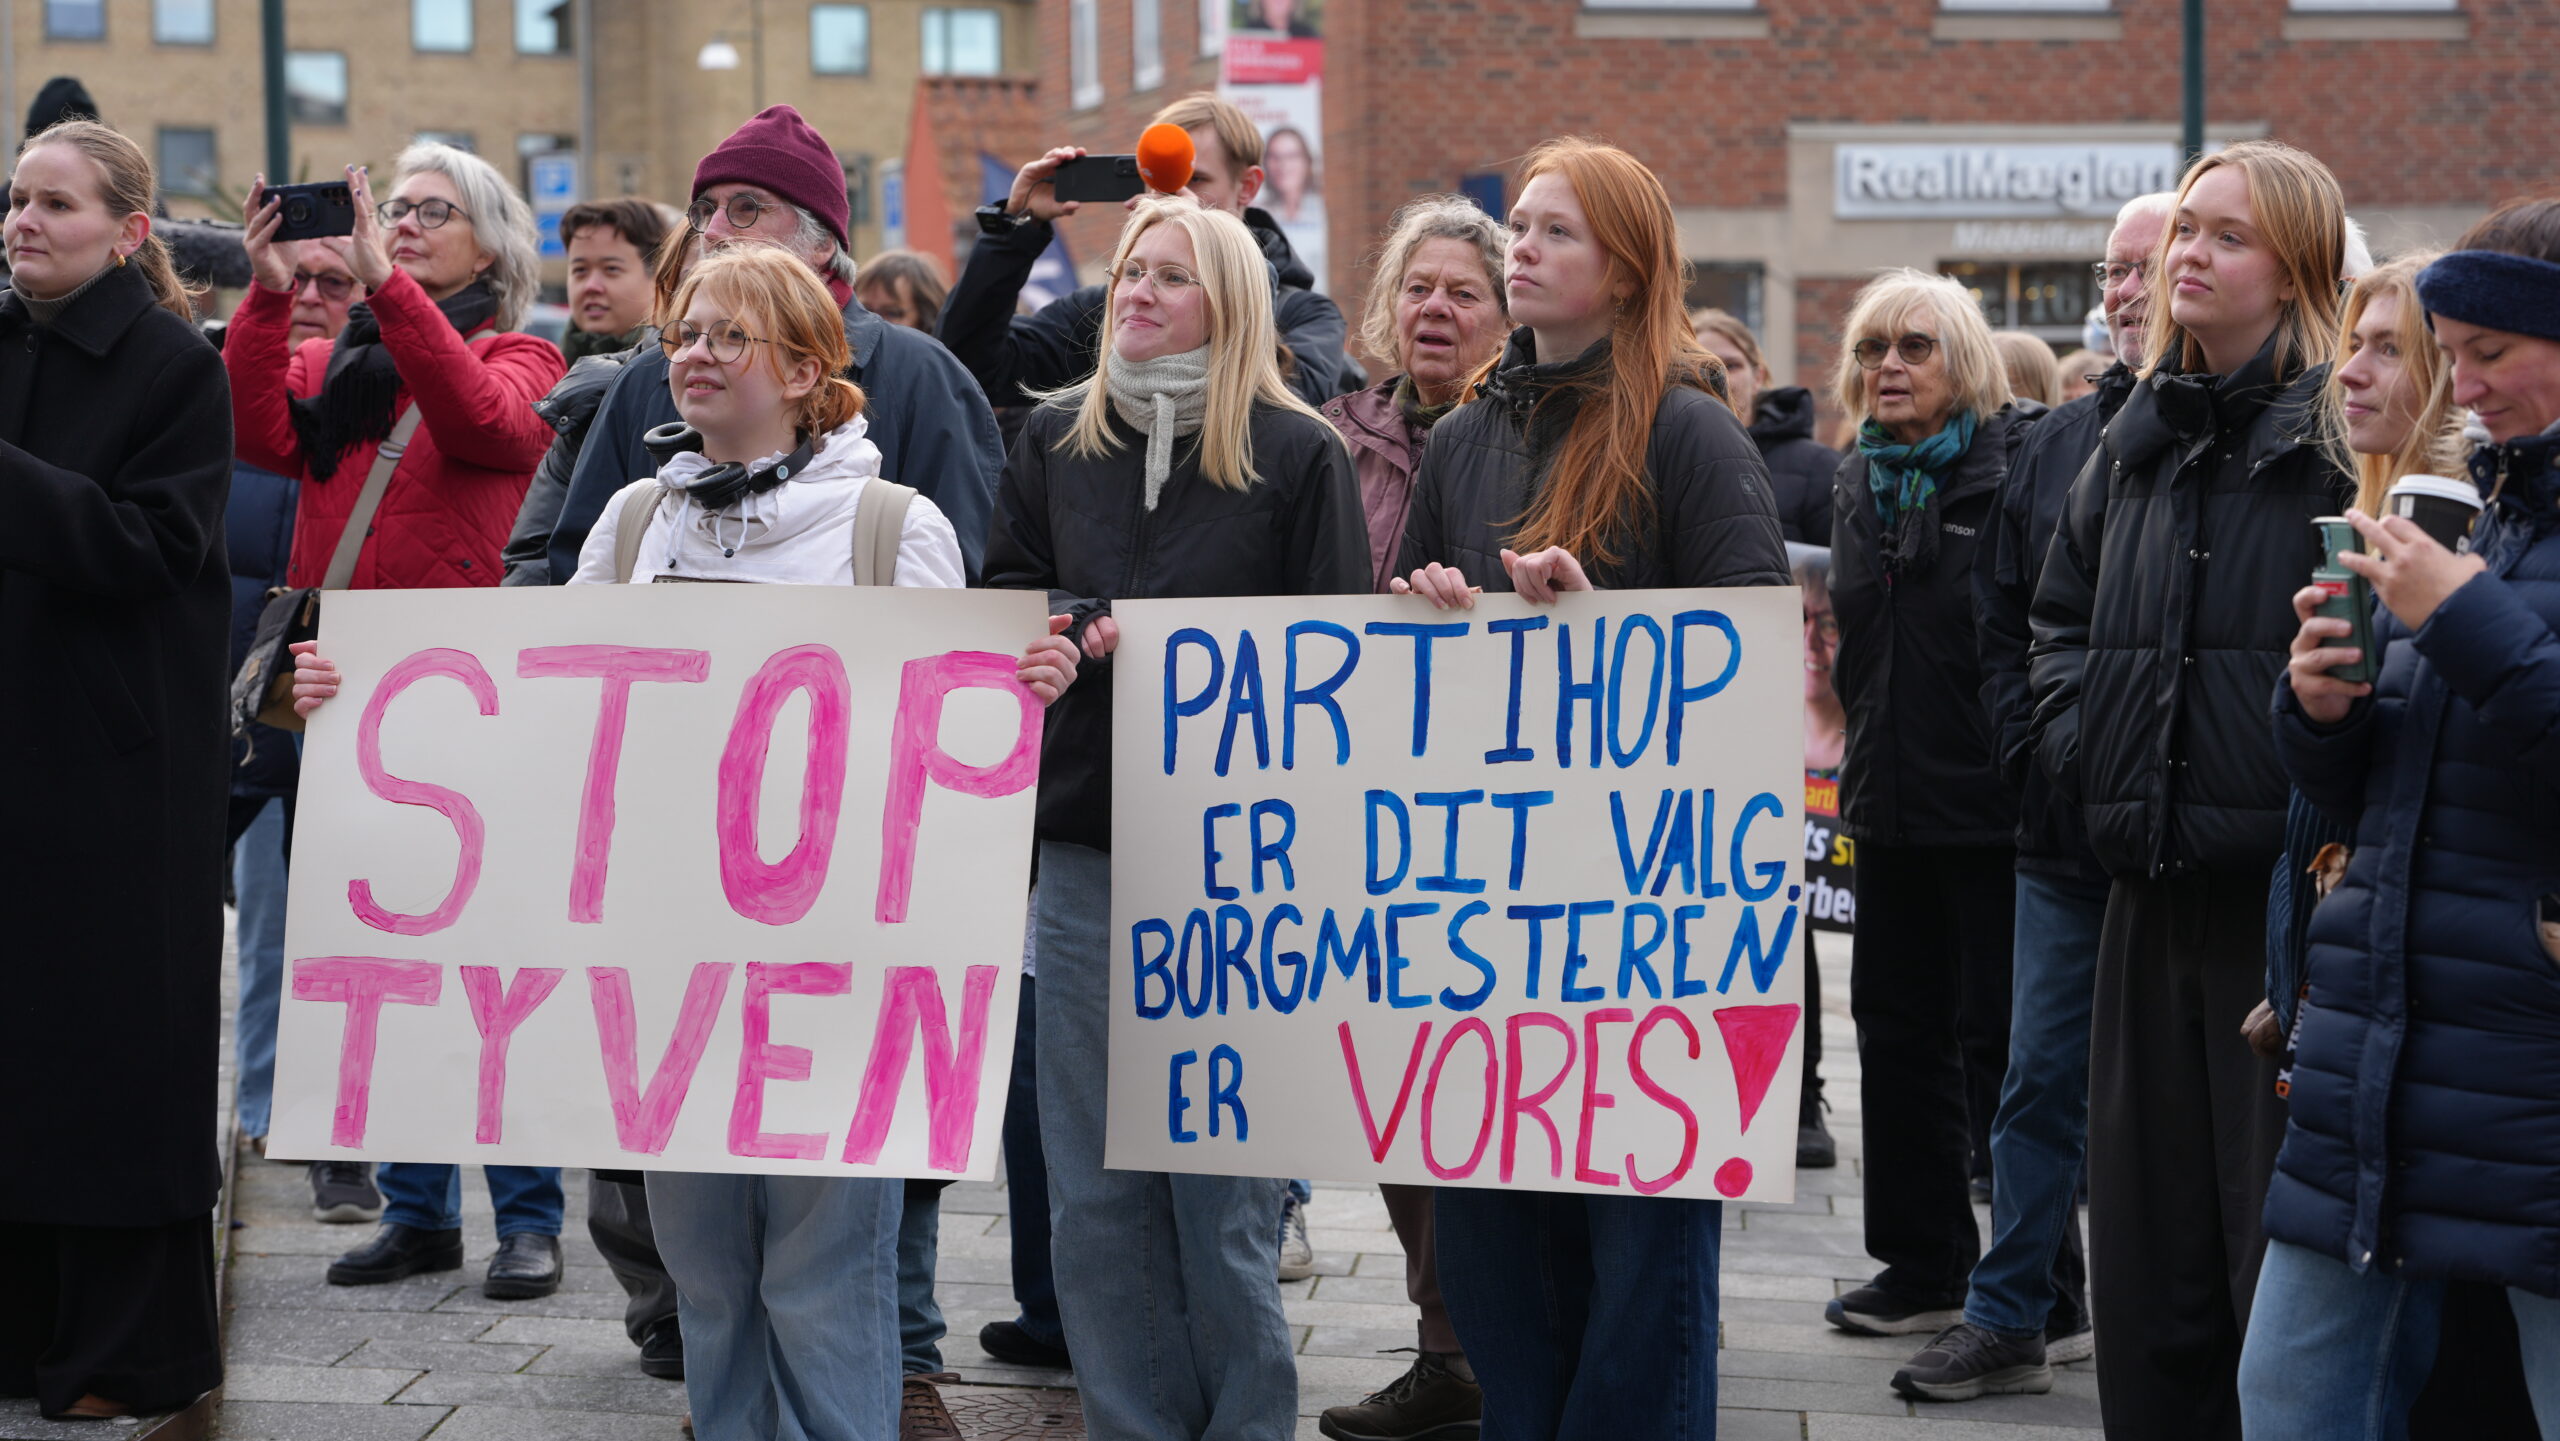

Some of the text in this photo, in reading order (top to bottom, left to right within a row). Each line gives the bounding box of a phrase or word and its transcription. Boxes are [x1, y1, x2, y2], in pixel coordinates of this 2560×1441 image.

[1163, 609, 1742, 777] PARTIHOP
[346, 642, 1046, 937] STOP
[1203, 788, 1801, 903] ER DIT VALG.
[1131, 899, 1800, 1021] BORGMESTEREN
[1804, 875, 1857, 924] rbe
[291, 956, 1000, 1174] TYVEN
[1168, 1002, 1801, 1198] ER VORES!
